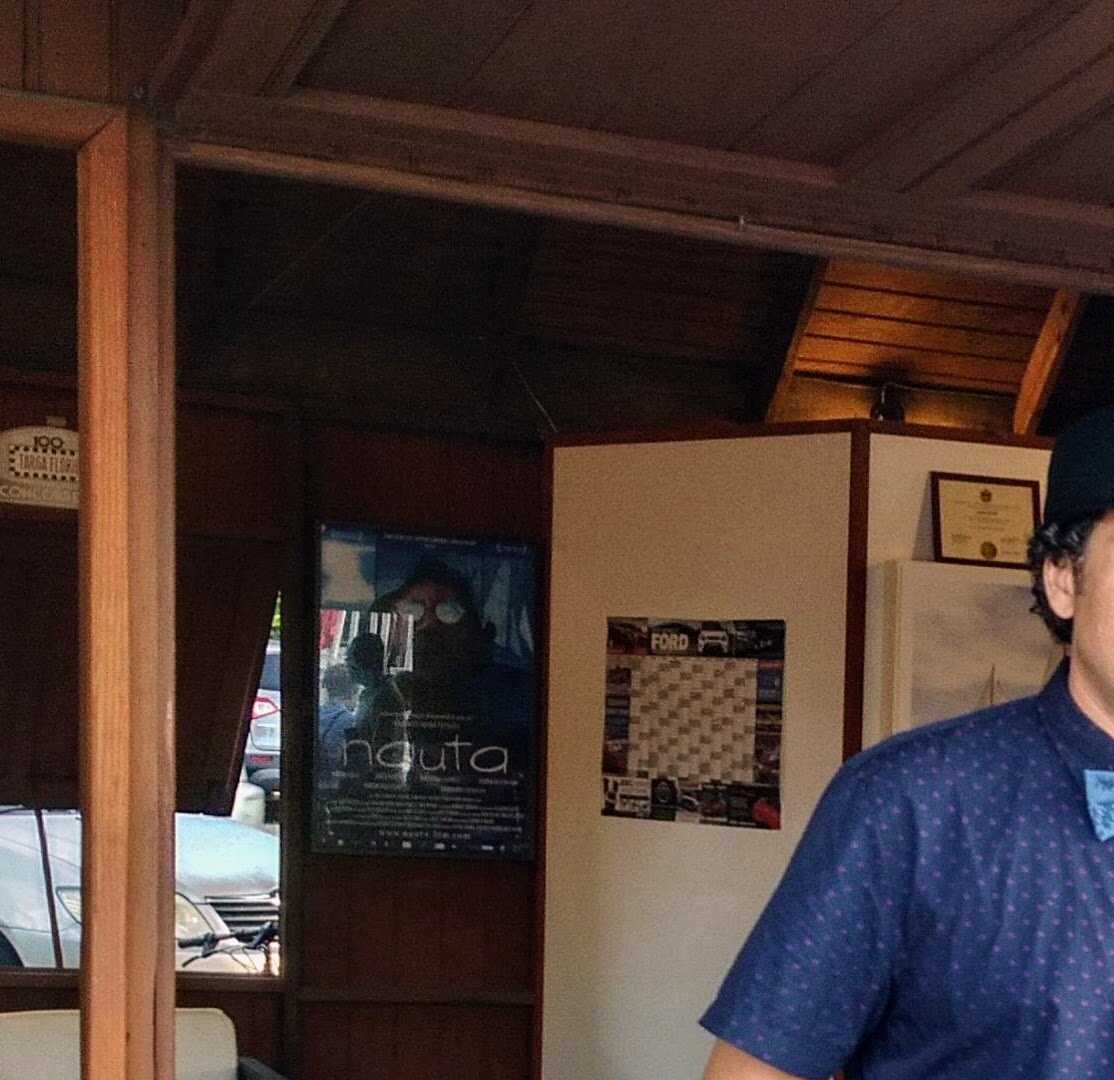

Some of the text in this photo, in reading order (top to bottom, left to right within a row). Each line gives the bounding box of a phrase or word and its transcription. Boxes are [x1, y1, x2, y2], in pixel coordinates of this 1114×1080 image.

[34, 435, 64, 449] 100
[651, 632, 688, 651] FORD
[342, 734, 508, 774] nauta
